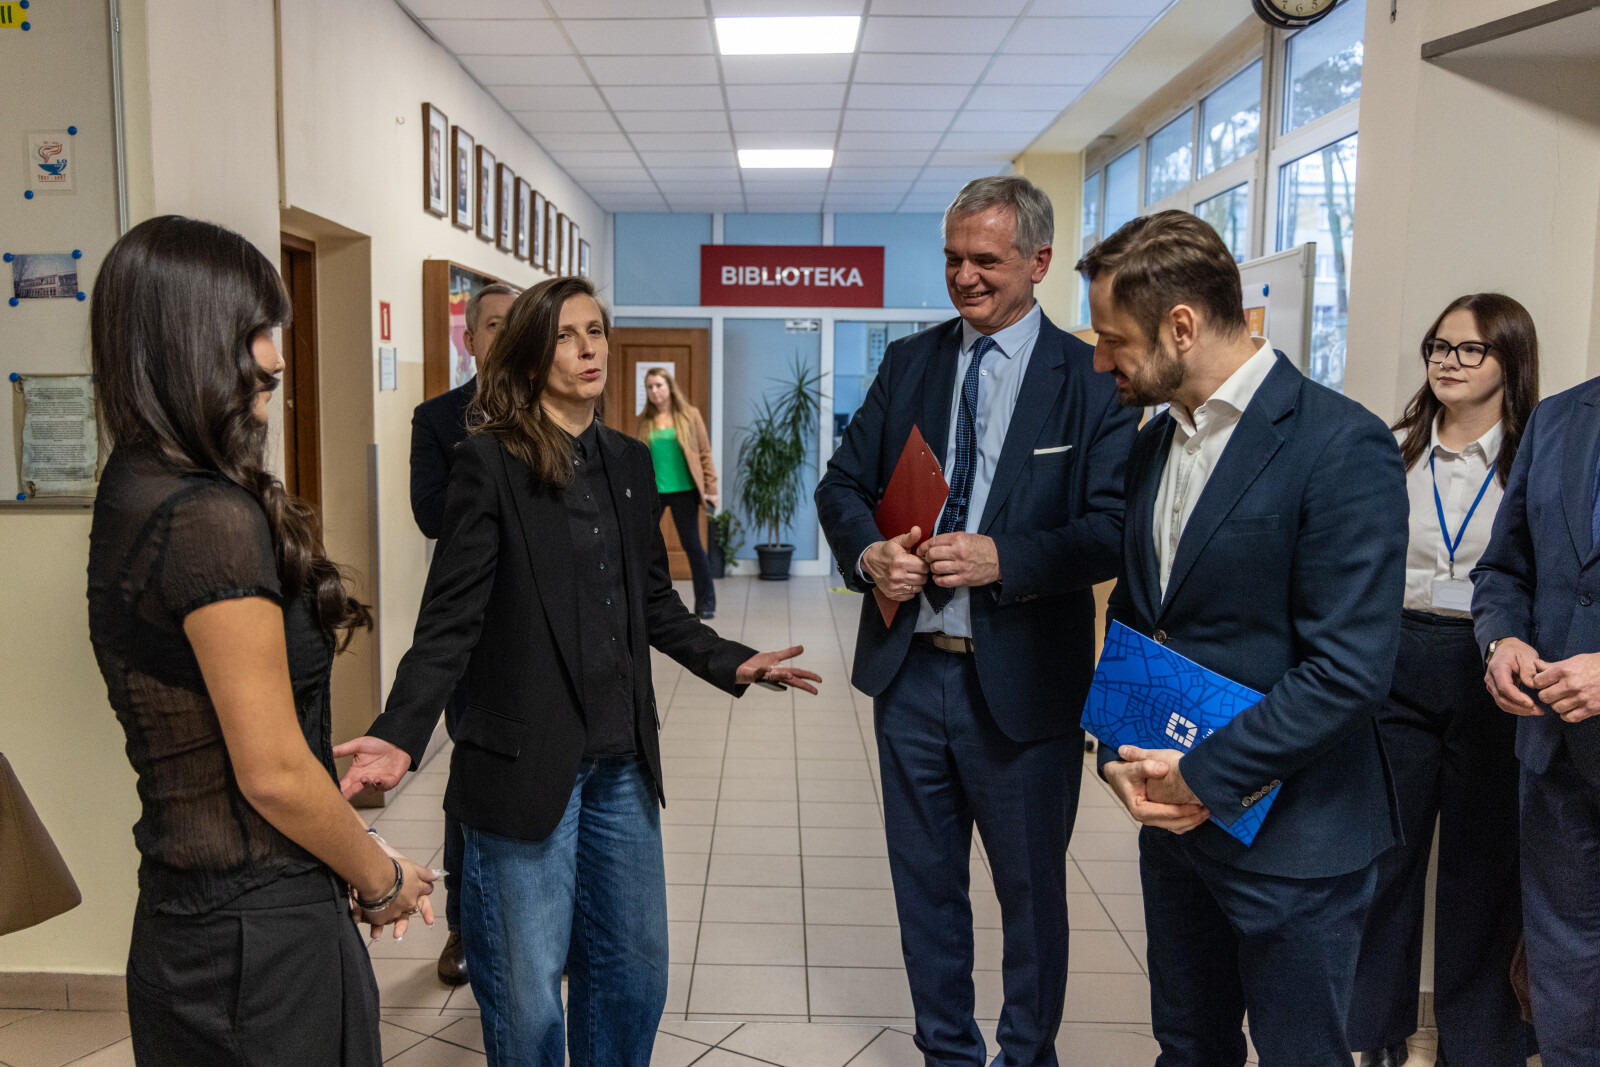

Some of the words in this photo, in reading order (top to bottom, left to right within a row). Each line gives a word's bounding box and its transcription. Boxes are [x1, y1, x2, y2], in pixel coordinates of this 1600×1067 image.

[1282, 0, 1288, 9] 7
[1295, 3, 1303, 12] 6
[721, 265, 864, 287] BIBLIOTEKA
